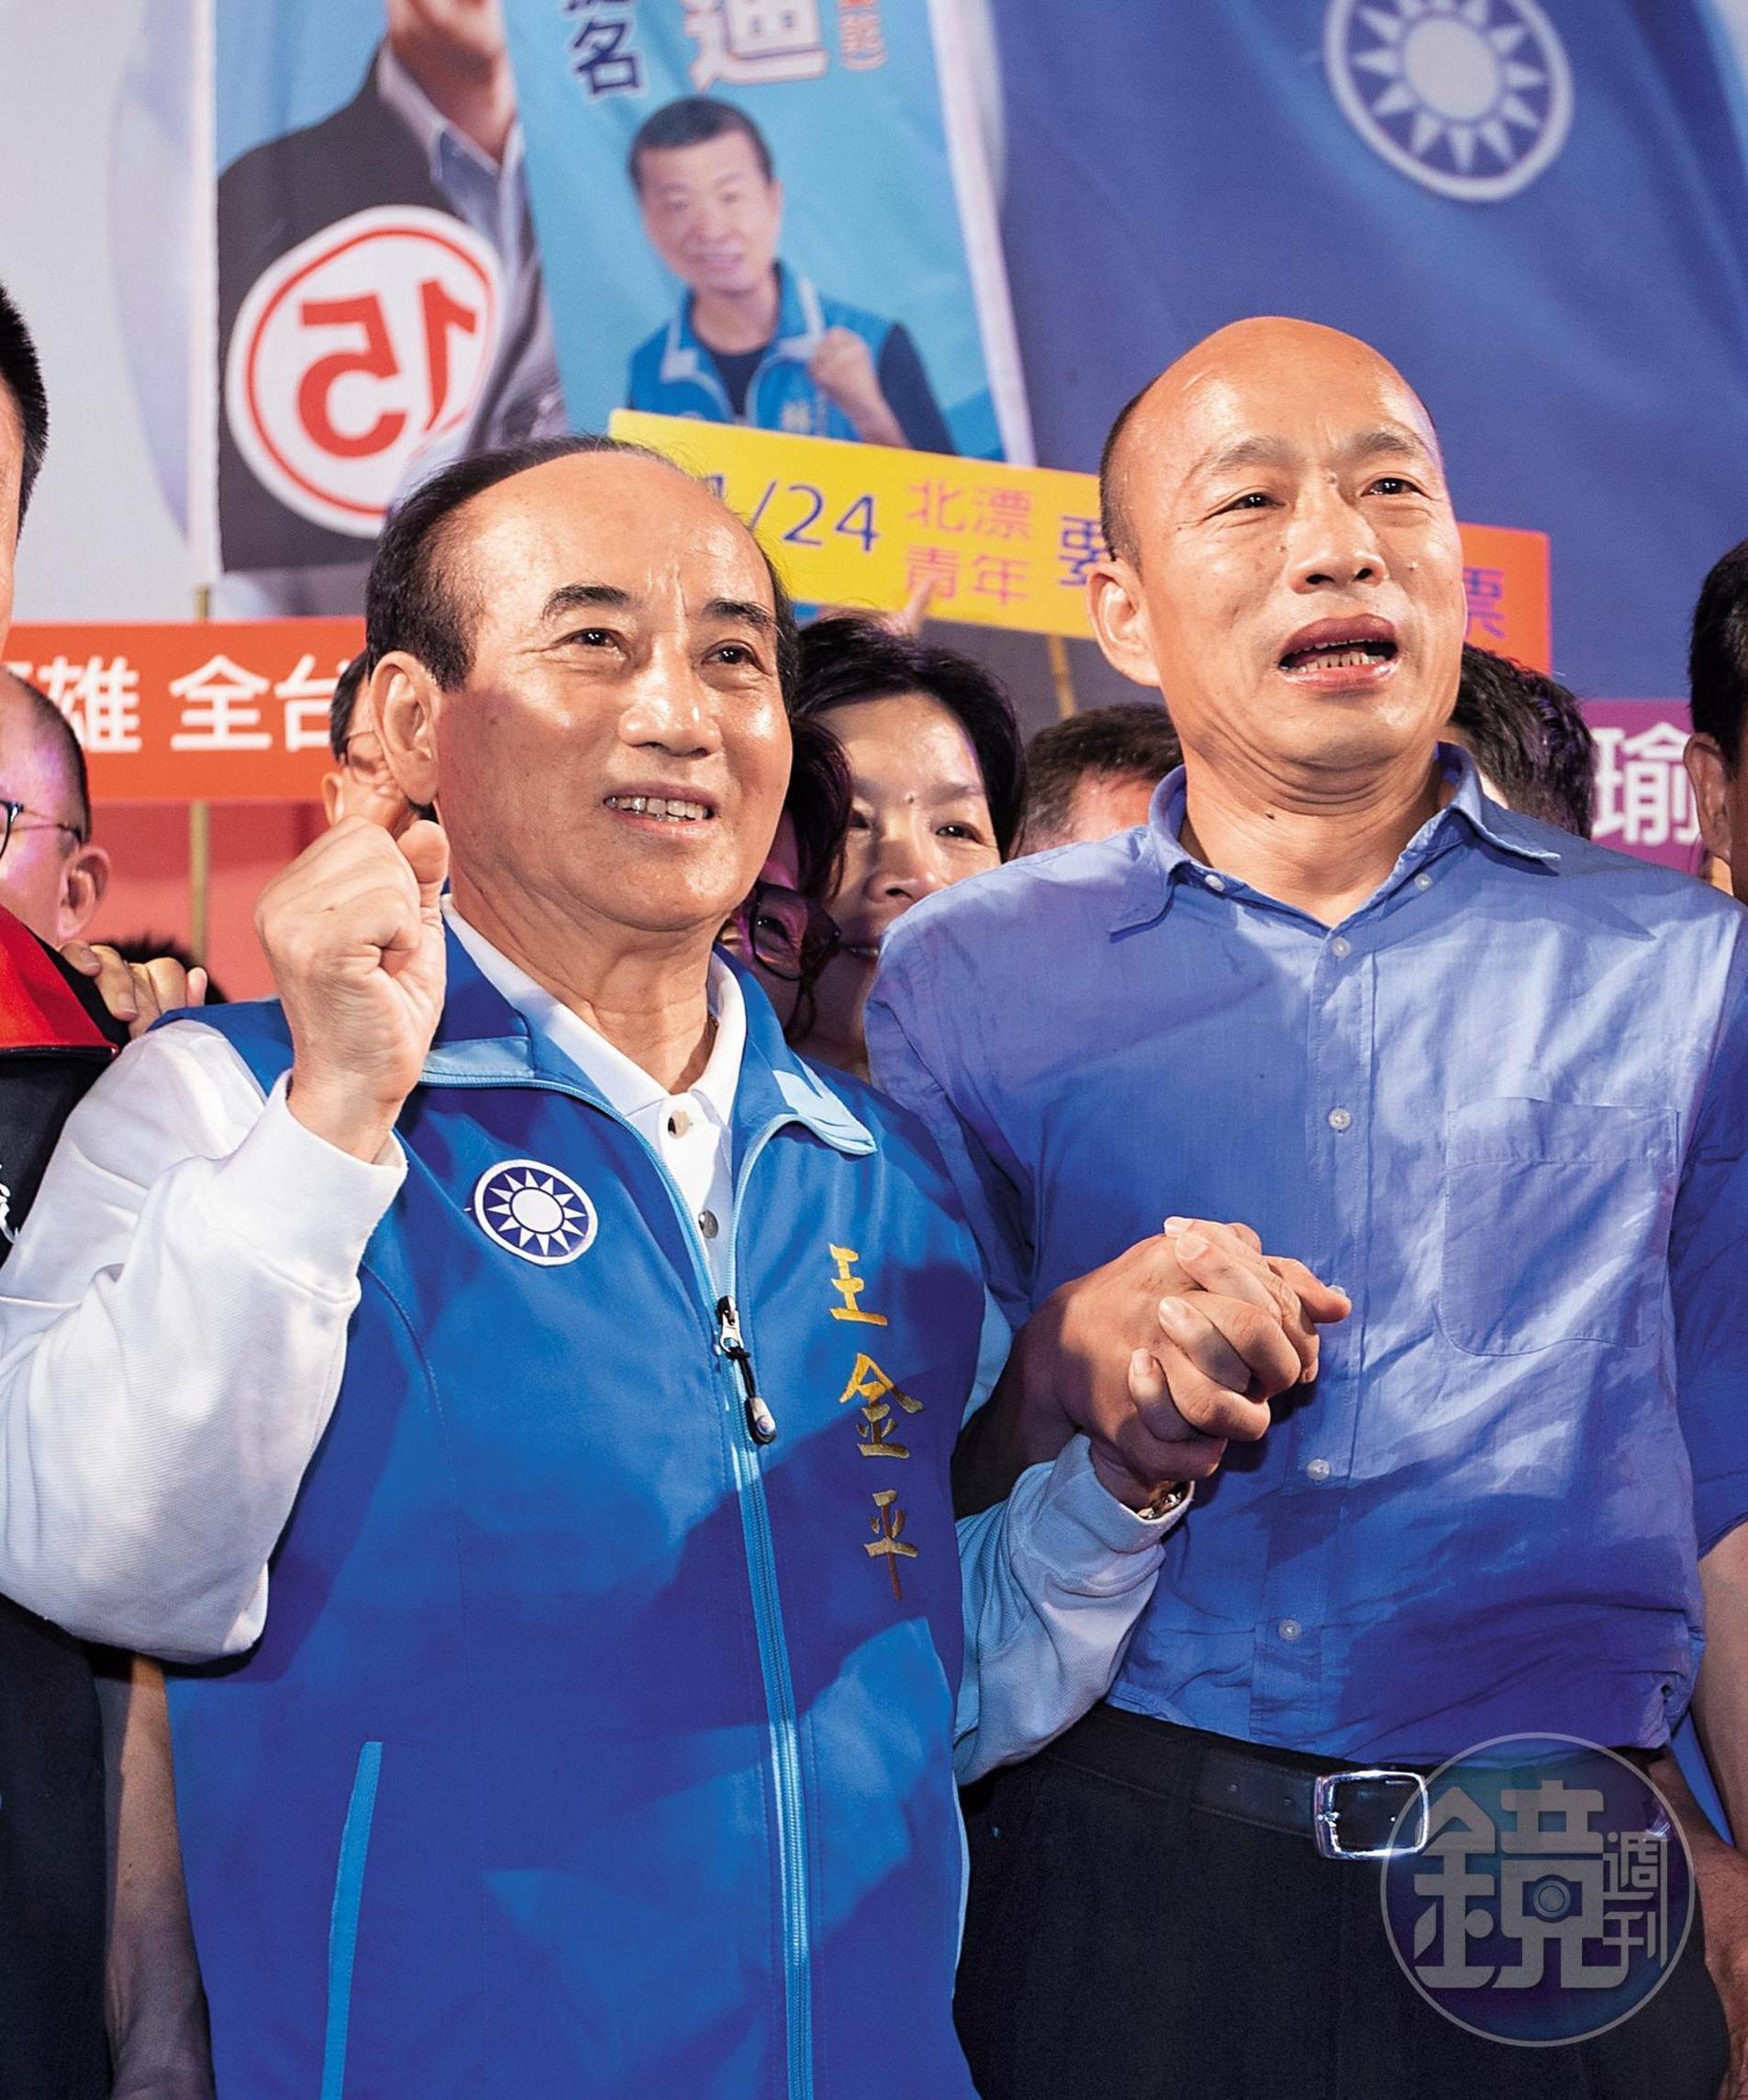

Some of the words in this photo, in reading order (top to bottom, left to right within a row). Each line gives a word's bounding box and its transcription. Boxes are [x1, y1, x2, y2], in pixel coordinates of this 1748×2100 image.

[568, 0, 640, 94] 名
[907, 478, 1033, 539] 北漂
[905, 545, 1030, 606] 青年
[0, 655, 142, 752] 雄
[1591, 721, 1702, 846] 瑜
[829, 1242, 925, 1603] 王金平
